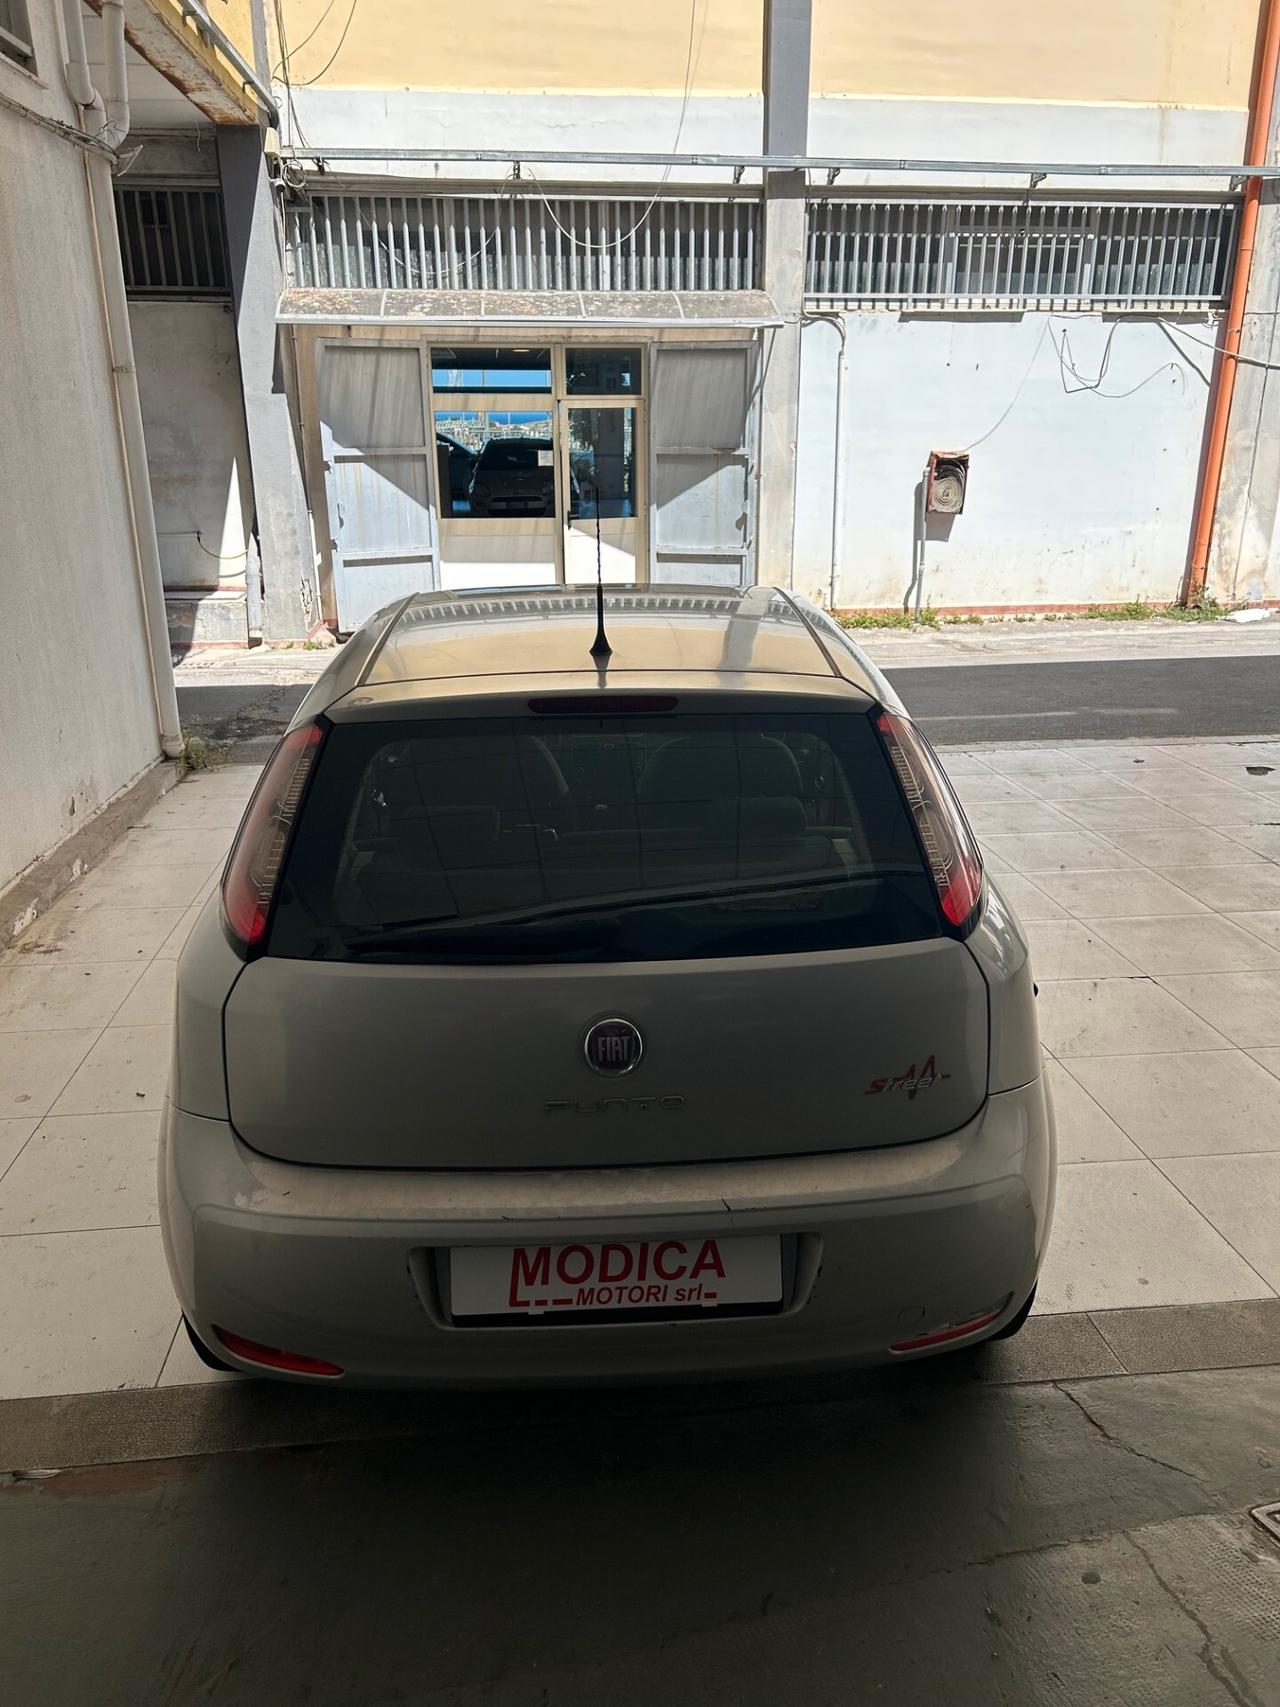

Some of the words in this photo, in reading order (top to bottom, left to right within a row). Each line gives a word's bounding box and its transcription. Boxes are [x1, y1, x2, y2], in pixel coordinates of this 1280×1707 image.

[598, 1036, 631, 1062] FIAT
[544, 1095, 686, 1113] PUNTO
[510, 1240, 726, 1287] MODICA
[576, 1285, 668, 1307] MOTORI
